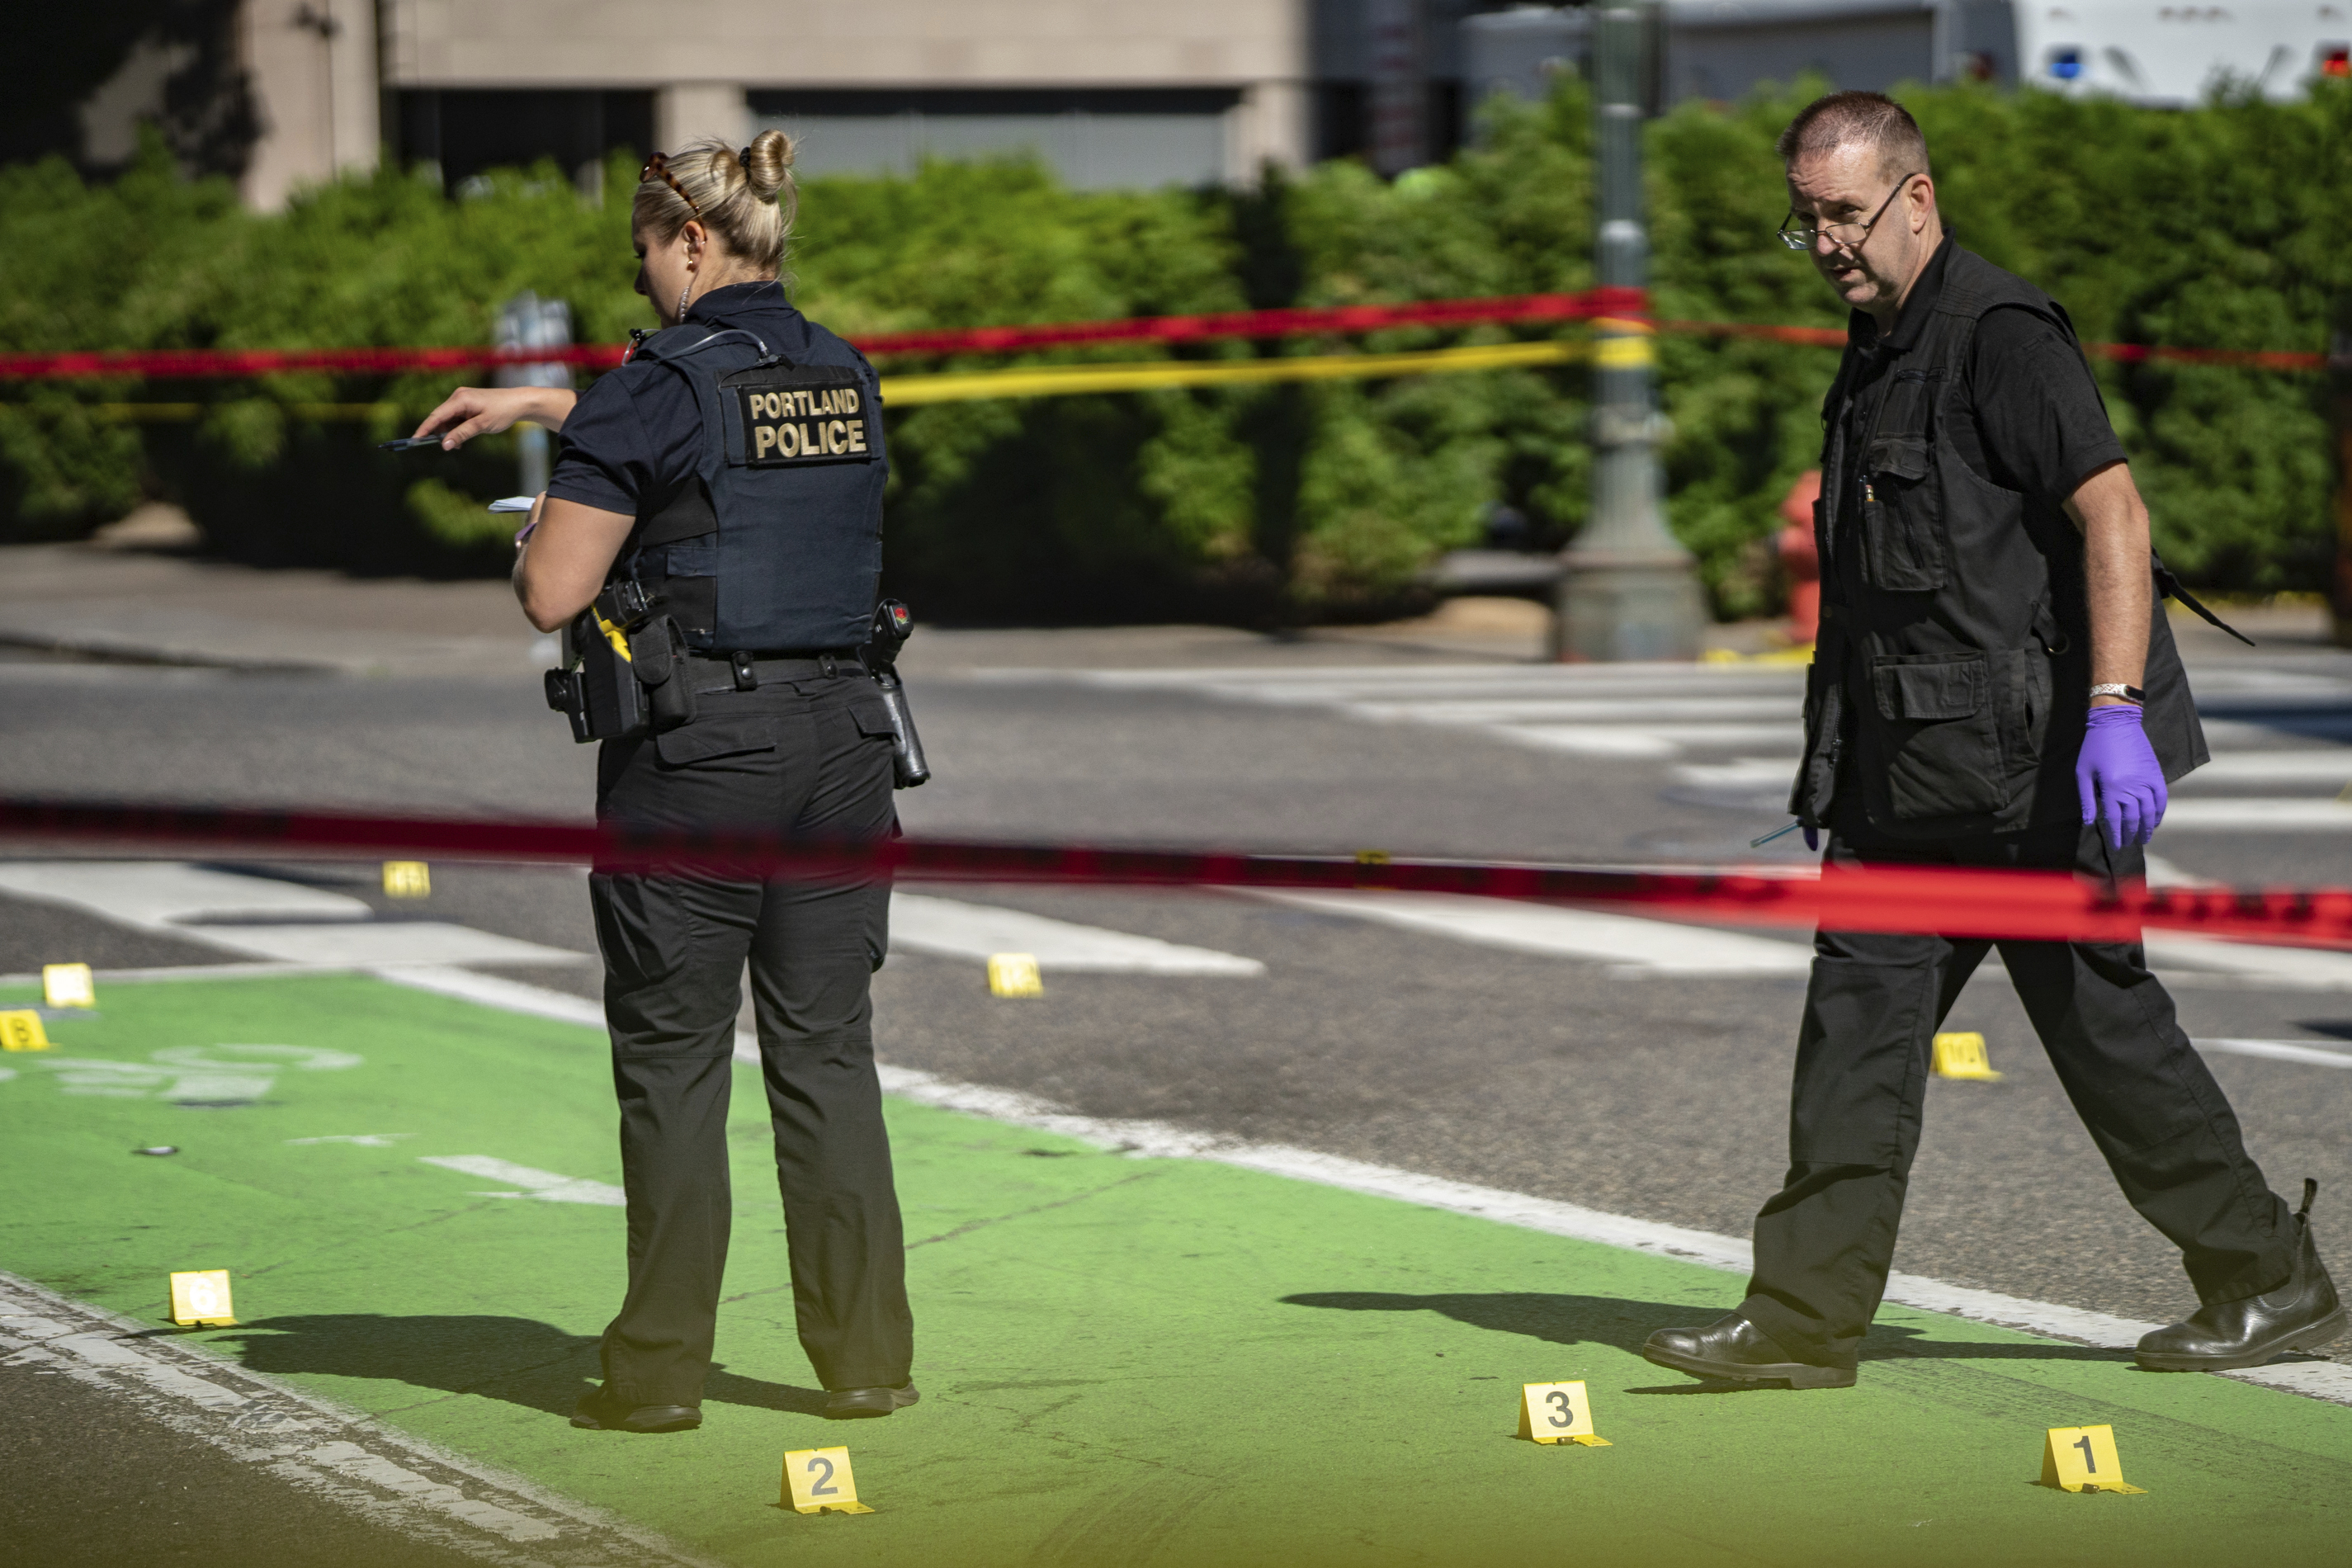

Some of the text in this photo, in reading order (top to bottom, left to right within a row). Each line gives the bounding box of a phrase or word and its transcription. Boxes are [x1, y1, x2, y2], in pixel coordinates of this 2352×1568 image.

[749, 388, 860, 419] PORTLAND
[754, 419, 867, 459] POLICE
[189, 1278, 218, 1313] 6
[1546, 1391, 1574, 1428] 3
[2072, 1435, 2096, 1473] 1
[807, 1457, 838, 1496] 2
